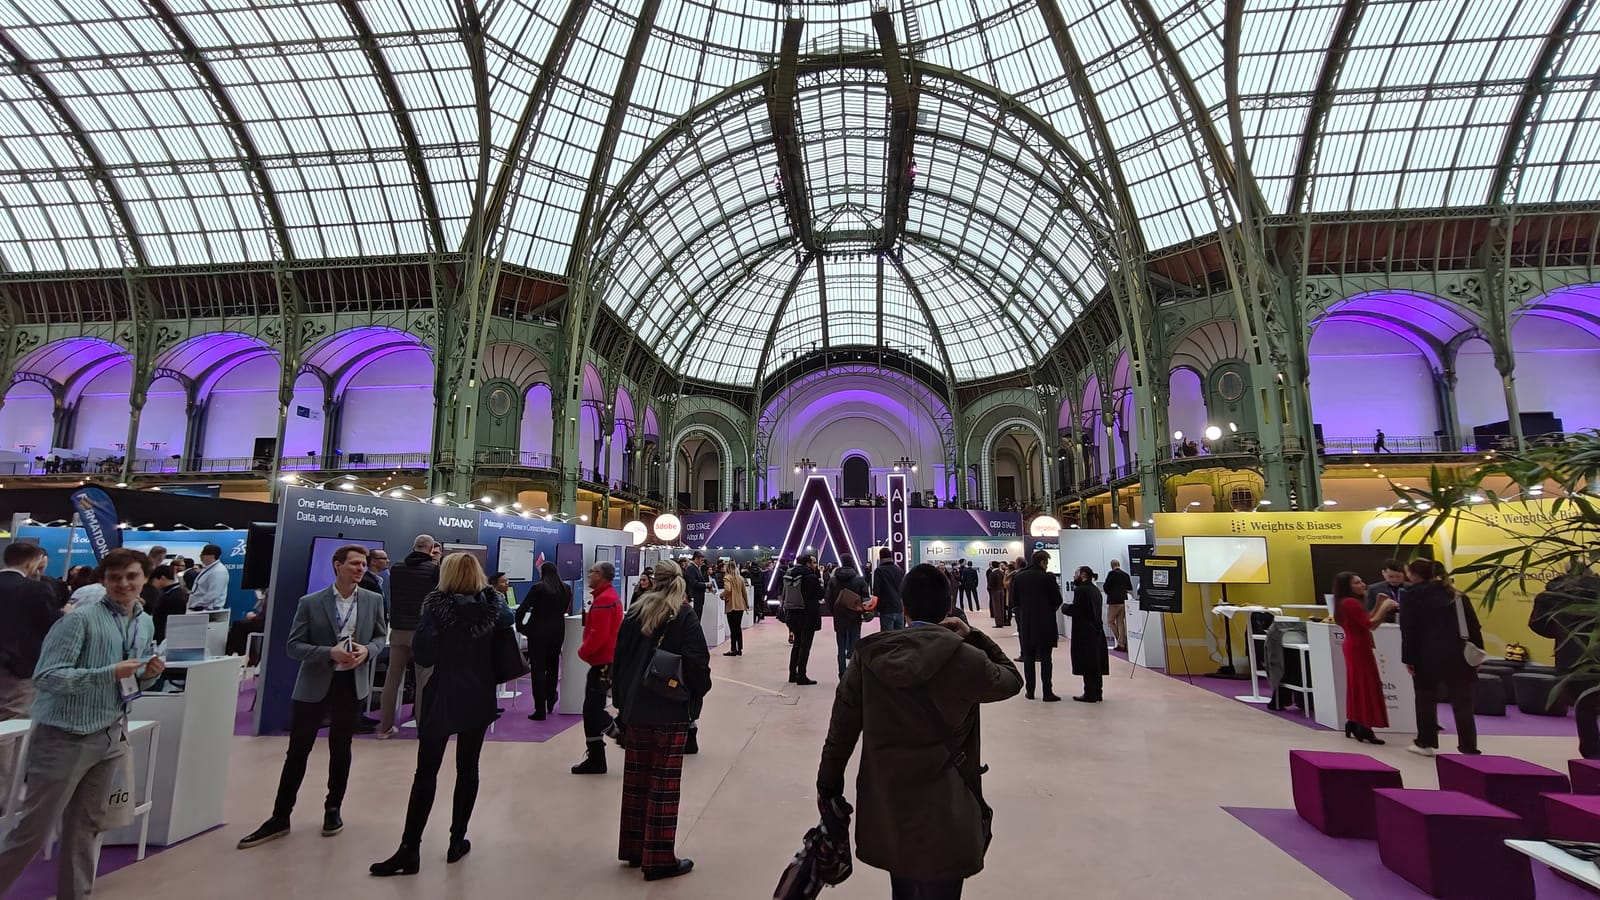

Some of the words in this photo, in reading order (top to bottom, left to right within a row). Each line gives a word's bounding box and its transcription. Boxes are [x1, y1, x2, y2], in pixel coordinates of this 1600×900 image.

[298, 498, 315, 509] One
[316, 500, 348, 512] Platform
[349, 504, 356, 513] to
[357, 505, 371, 514] Run
[371, 506, 389, 518] Apps,
[296, 511, 317, 523] Data,
[318, 513, 333, 523] and
[334, 515, 342, 524] AI
[343, 515, 378, 527] Anywhere.
[438, 516, 474, 529] NUTANIX
[989, 520, 1001, 529] CEO
[1001, 521, 1017, 529] STAGE
[655, 522, 677, 530] Adobe
[696, 522, 711, 530] STAGE
[891, 488, 904, 567] Adop
[1250, 521, 1295, 533] Weights
[1296, 521, 1305, 531] &
[1307, 520, 1342, 531] Biases
[926, 546, 953, 556] HPE
